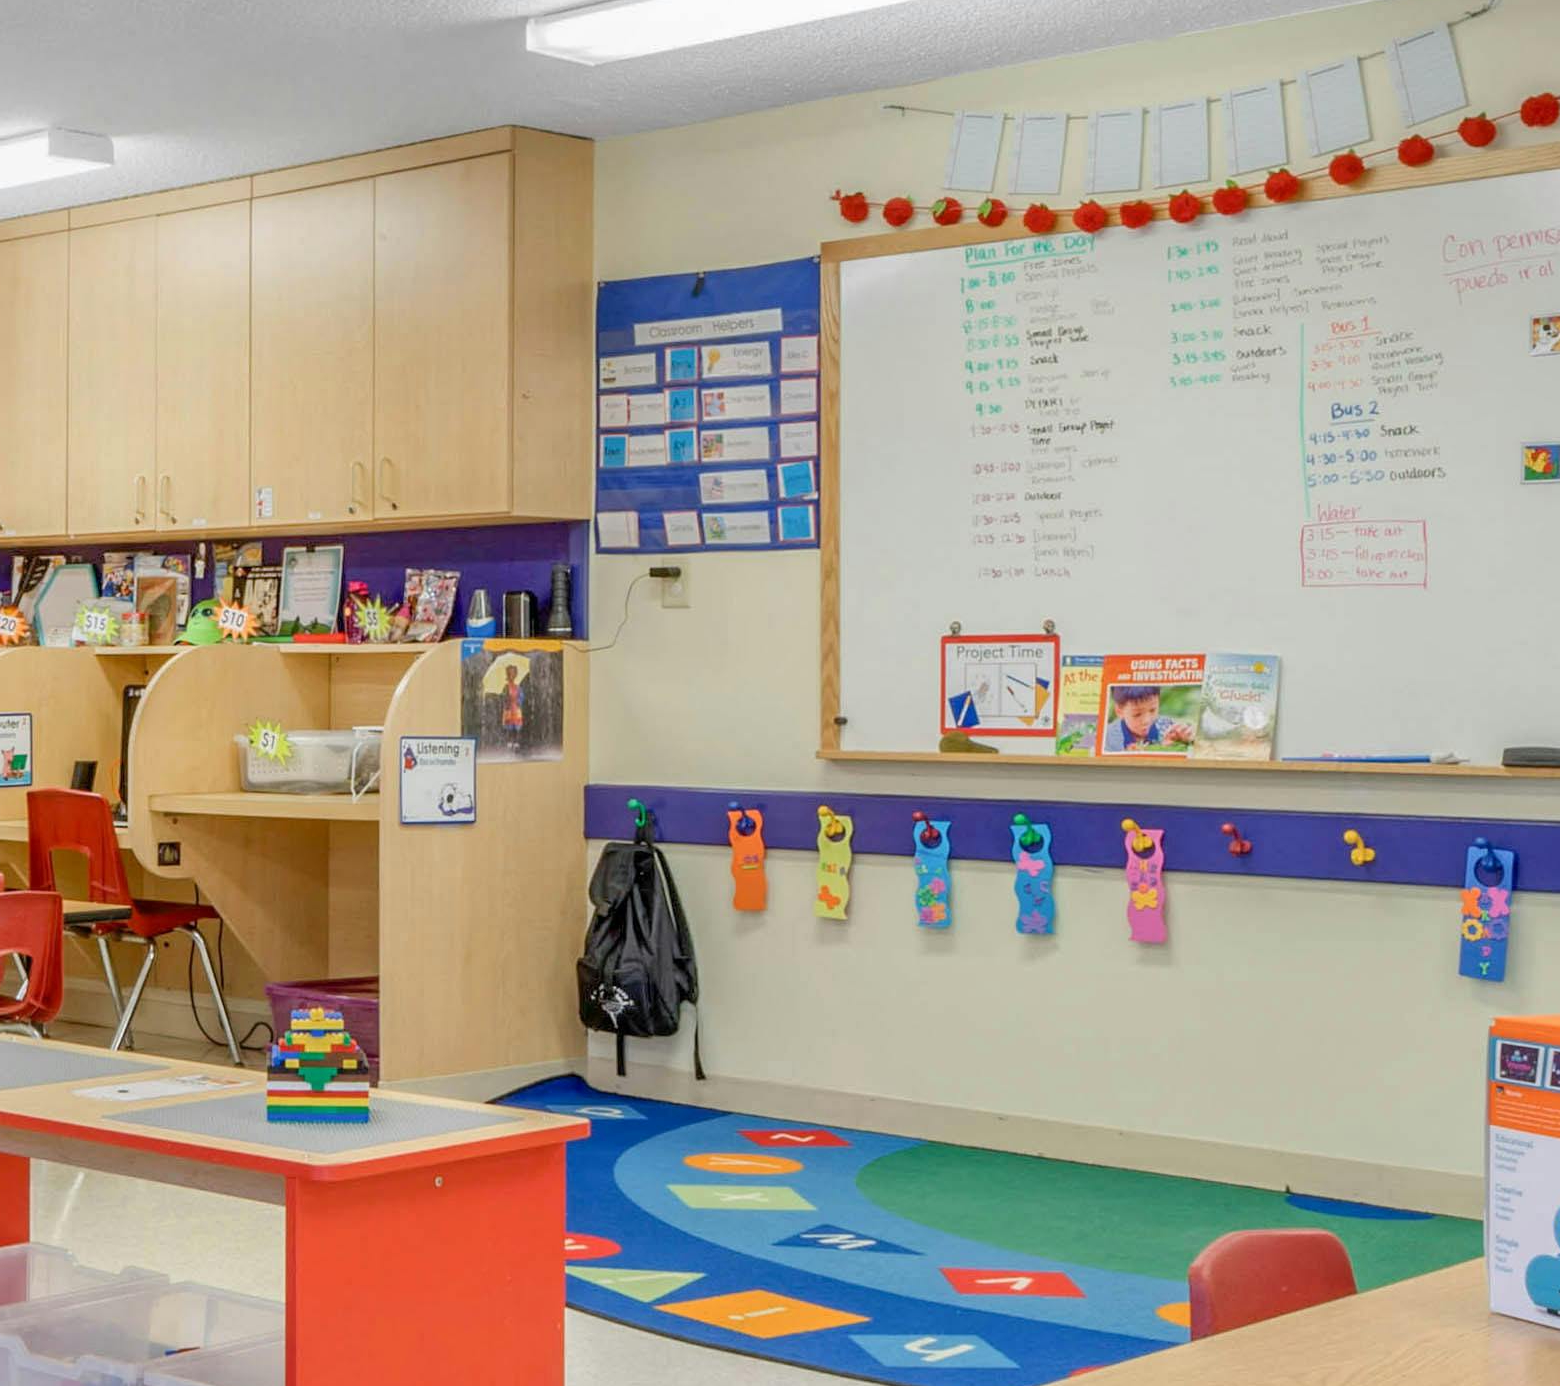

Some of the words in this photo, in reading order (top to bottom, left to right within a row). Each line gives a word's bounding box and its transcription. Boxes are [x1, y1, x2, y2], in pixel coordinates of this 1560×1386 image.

[965, 247, 996, 263] Plan
[649, 324, 703, 339] Classroom
[712, 317, 755, 333] Helpers
[1331, 321, 1356, 335] Bus
[1331, 403, 1363, 419] Bus
[1369, 401, 1380, 415] 2
[1380, 424, 1419, 437] Snack
[85, 616, 105, 630] $15
[221, 609, 245, 628] $10
[366, 611, 377, 626] $5
[956, 646, 1004, 661] Project
[1009, 645, 1043, 659] Time
[1131, 659, 1163, 670] USING
[1165, 658, 1198, 669] FACTS
[1064, 674, 1077, 685] At
[1079, 669, 1099, 682] the
[261, 731, 276, 747] $1
[417, 742, 460, 756] Listening
